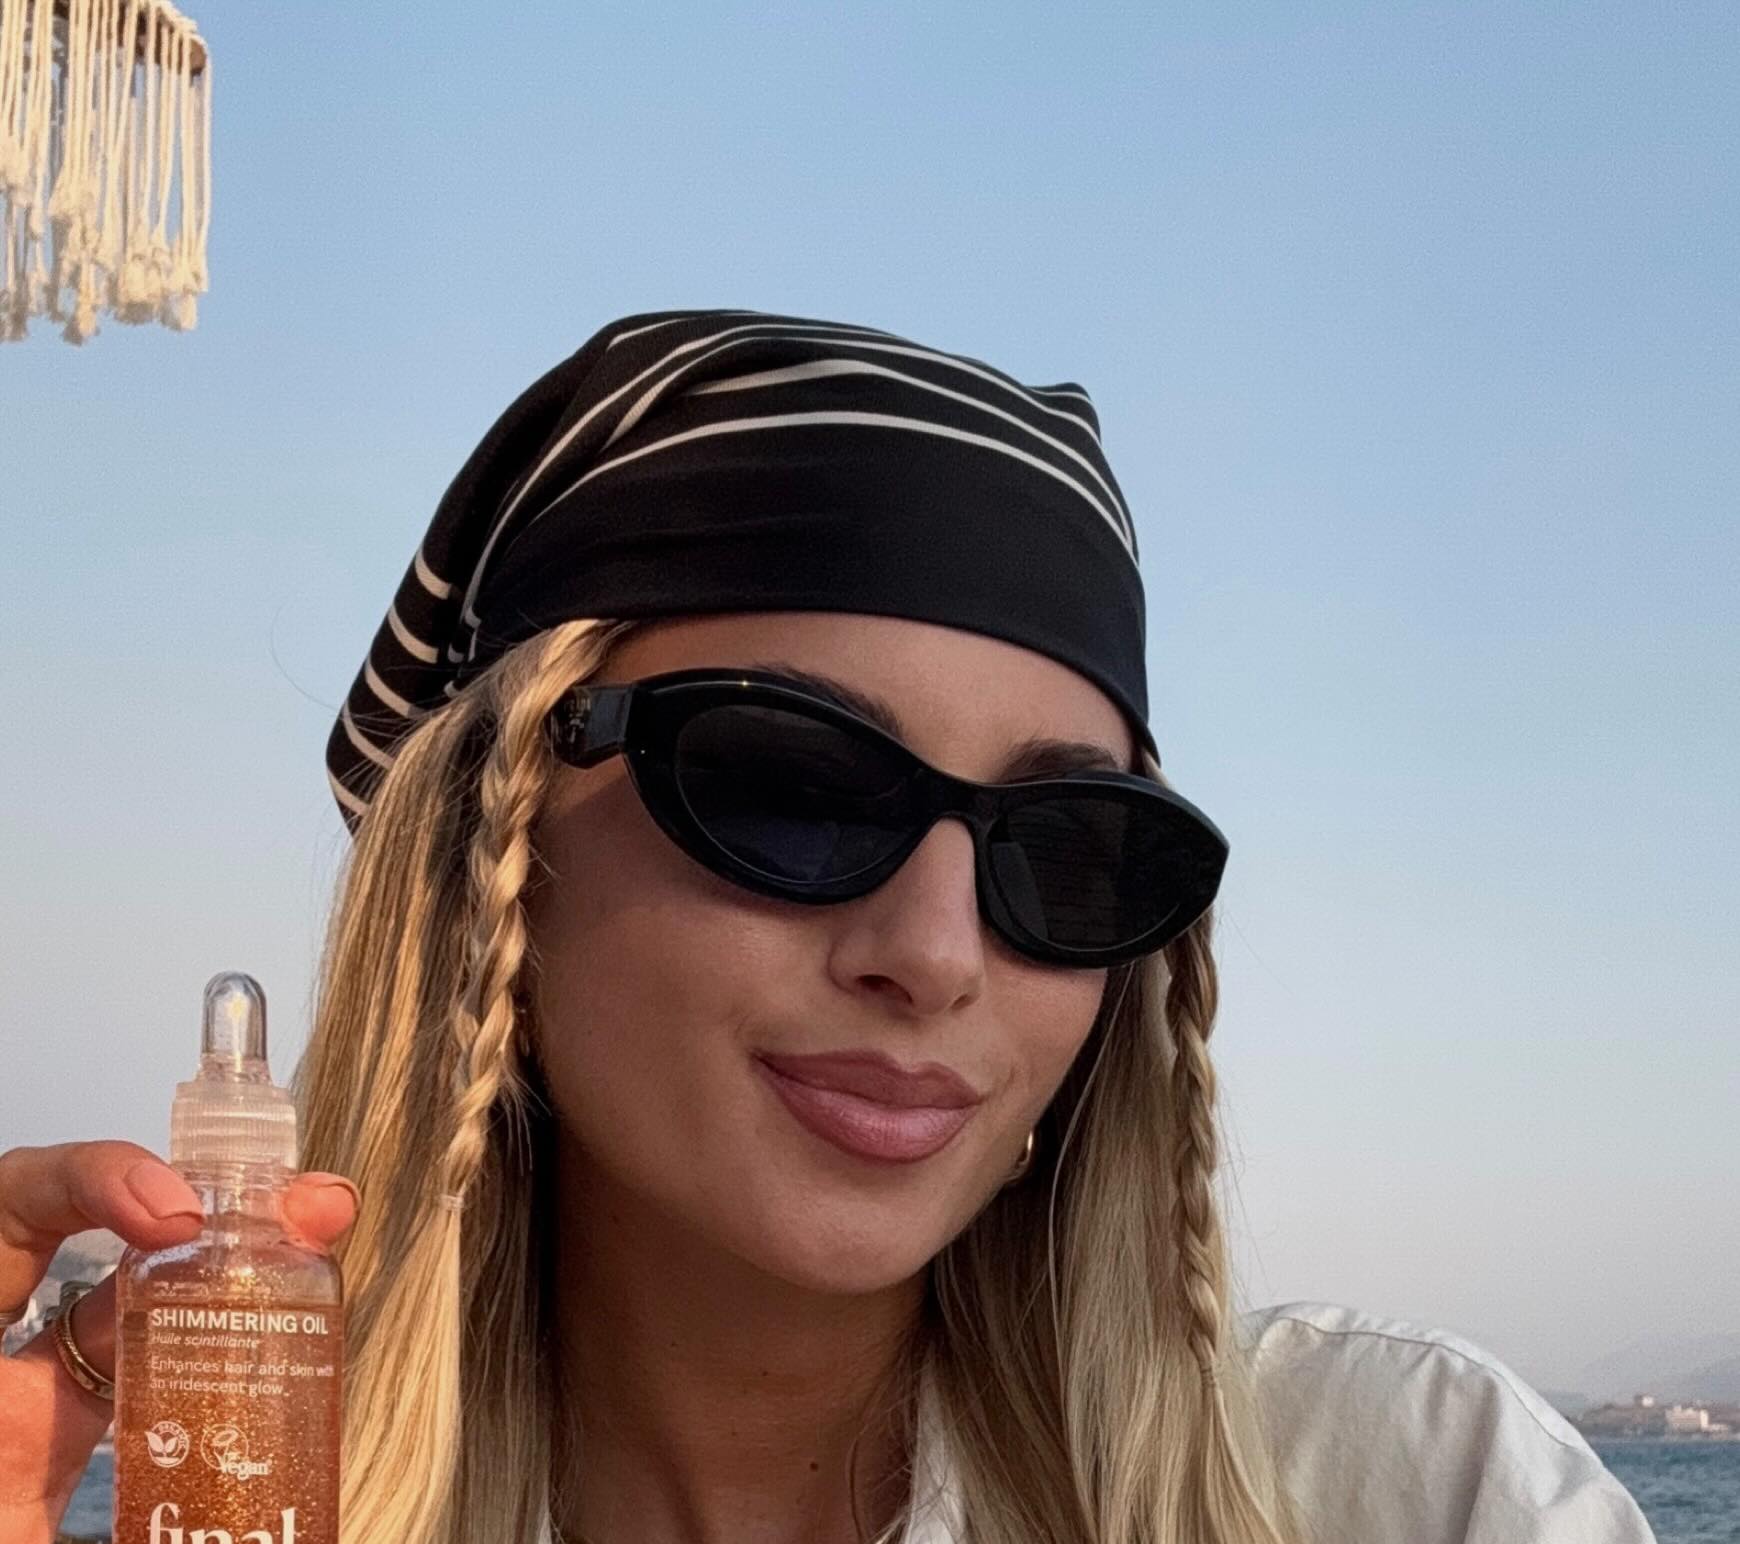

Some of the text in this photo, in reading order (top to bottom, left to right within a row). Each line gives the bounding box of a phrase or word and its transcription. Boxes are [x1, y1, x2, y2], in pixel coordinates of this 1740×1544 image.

[151, 1308, 329, 1335] SHIMMERING OIL
[151, 1333, 260, 1349] Huile scintillante
[151, 1356, 219, 1373] Enhances
[224, 1360, 254, 1374] hair
[258, 1361, 286, 1376] and
[290, 1363, 314, 1377] skin
[151, 1378, 166, 1389] an
[169, 1377, 246, 1393] iridescent
